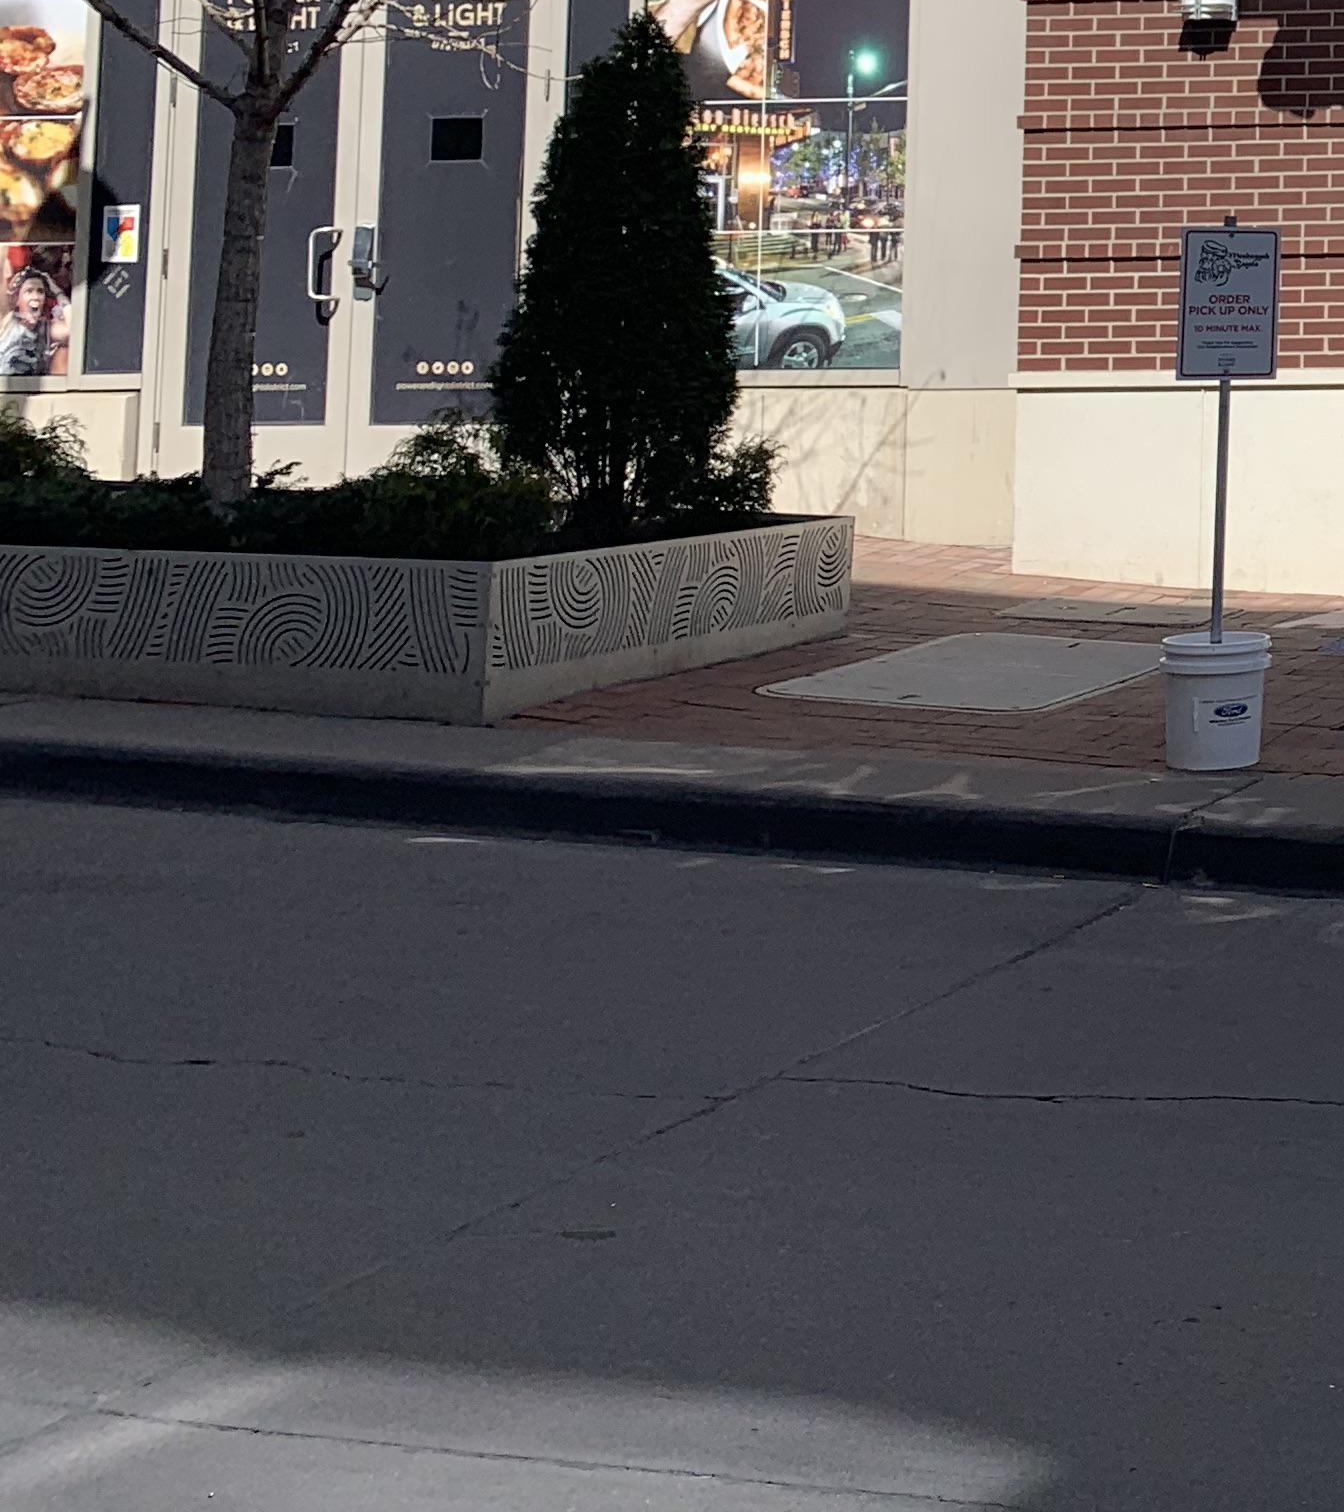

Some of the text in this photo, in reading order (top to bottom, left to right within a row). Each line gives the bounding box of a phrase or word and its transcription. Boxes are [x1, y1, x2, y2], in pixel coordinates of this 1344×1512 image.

[434, 2, 507, 27] LIGHT
[1208, 294, 1250, 305] ORDER
[1189, 306, 1270, 316] PICK UP ONLY
[1194, 325, 1204, 333] 10
[1205, 325, 1239, 333] MINUTE
